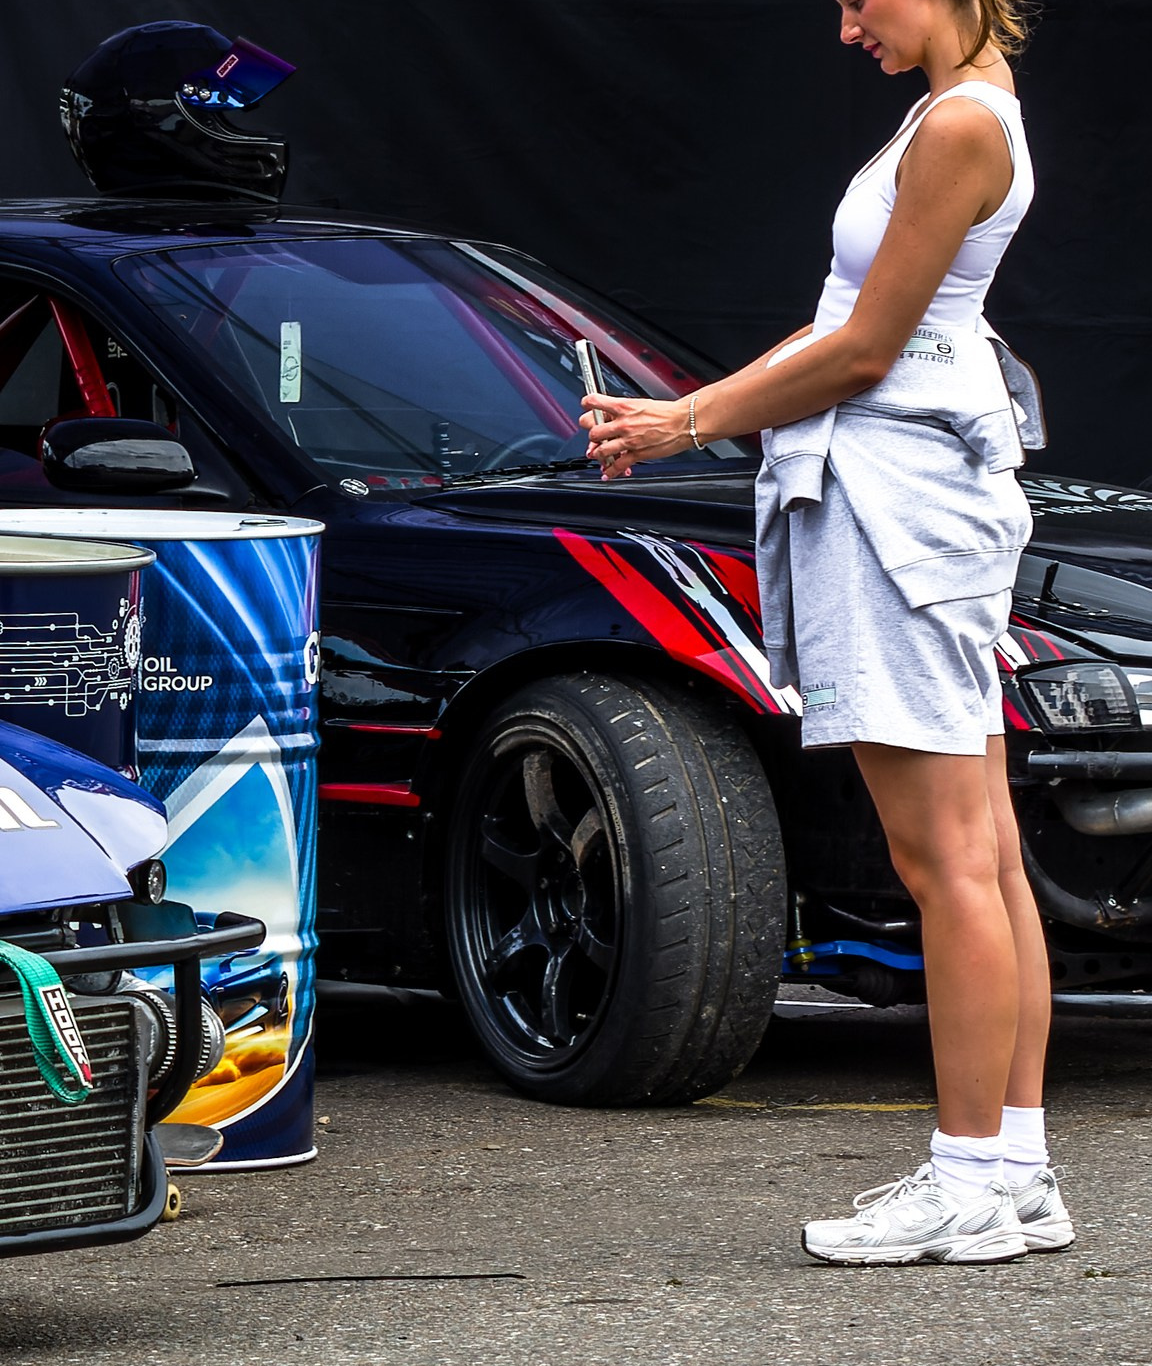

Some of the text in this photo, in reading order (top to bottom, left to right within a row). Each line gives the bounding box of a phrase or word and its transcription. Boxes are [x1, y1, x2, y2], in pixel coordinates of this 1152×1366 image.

[144, 656, 178, 673] OIL
[143, 675, 213, 692] GROUP
[46, 989, 89, 1066] HOOK
